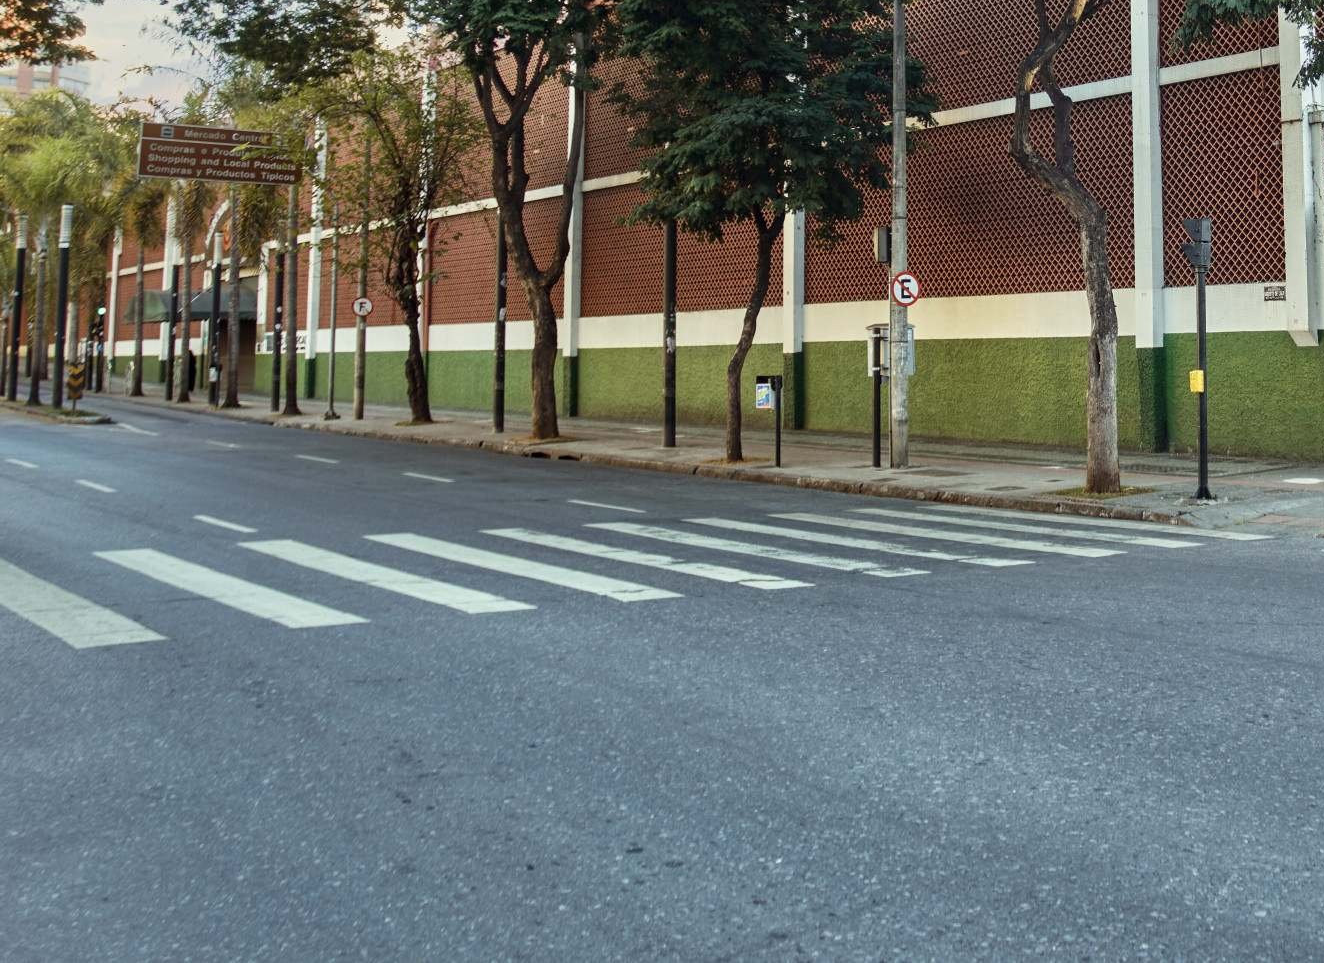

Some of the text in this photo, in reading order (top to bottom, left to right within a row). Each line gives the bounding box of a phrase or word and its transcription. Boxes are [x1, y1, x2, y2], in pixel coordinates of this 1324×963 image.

[184, 129, 227, 140] Mercado
[150, 143, 196, 155] Compras
[148, 154, 197, 166] Shopping
[201, 157, 219, 166] and
[223, 158, 250, 168] Local
[146, 165, 192, 176] Compras
[196, 169, 202, 177] y
[206, 169, 256, 179] Productos
[901, 279, 911, 298] E
